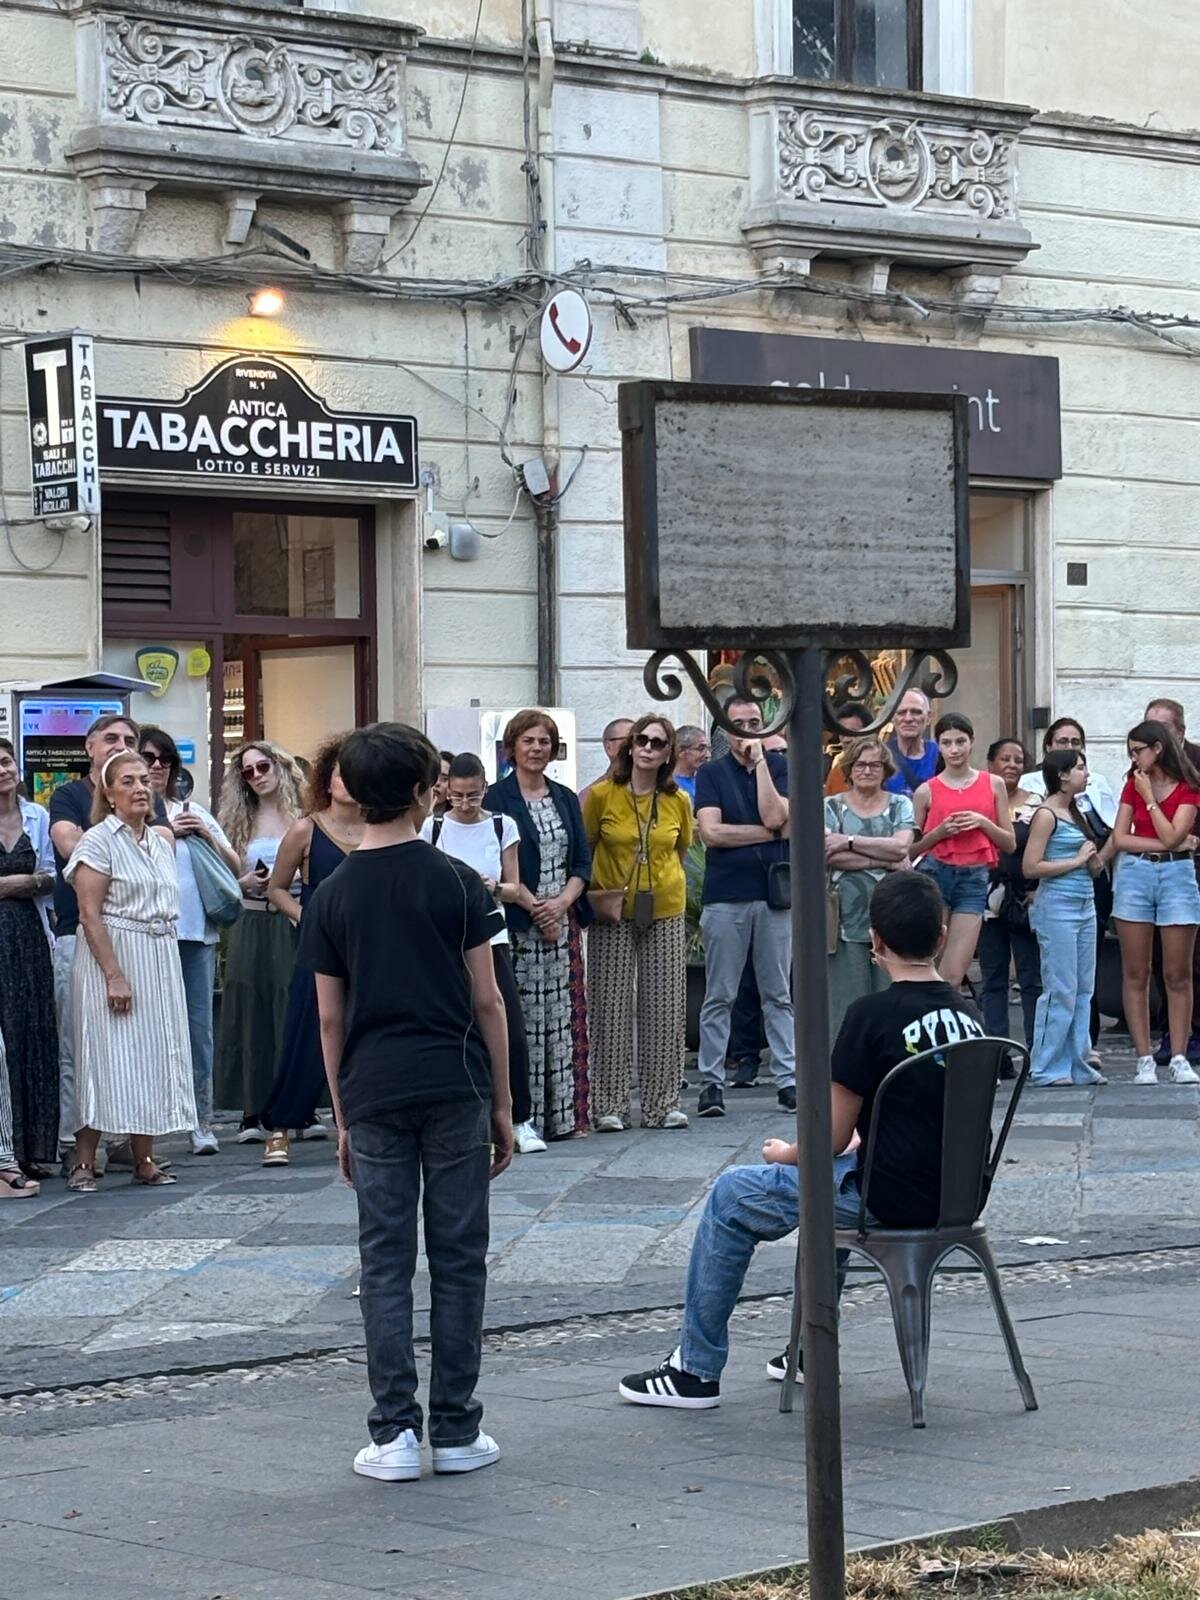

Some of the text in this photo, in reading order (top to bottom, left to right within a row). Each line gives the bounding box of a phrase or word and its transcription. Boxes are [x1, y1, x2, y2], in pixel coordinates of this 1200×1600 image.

[235, 368, 278, 380] RIVENDITA
[260, 381, 266, 390] 1
[32, 349, 68, 446] T
[227, 399, 288, 417] ANTICA
[78, 343, 96, 504] TABACCHI
[103, 408, 405, 465] TABACCHERIA
[34, 458, 76, 478] TABACCHI
[196, 458, 321, 478] LOTTO E SERVIZI
